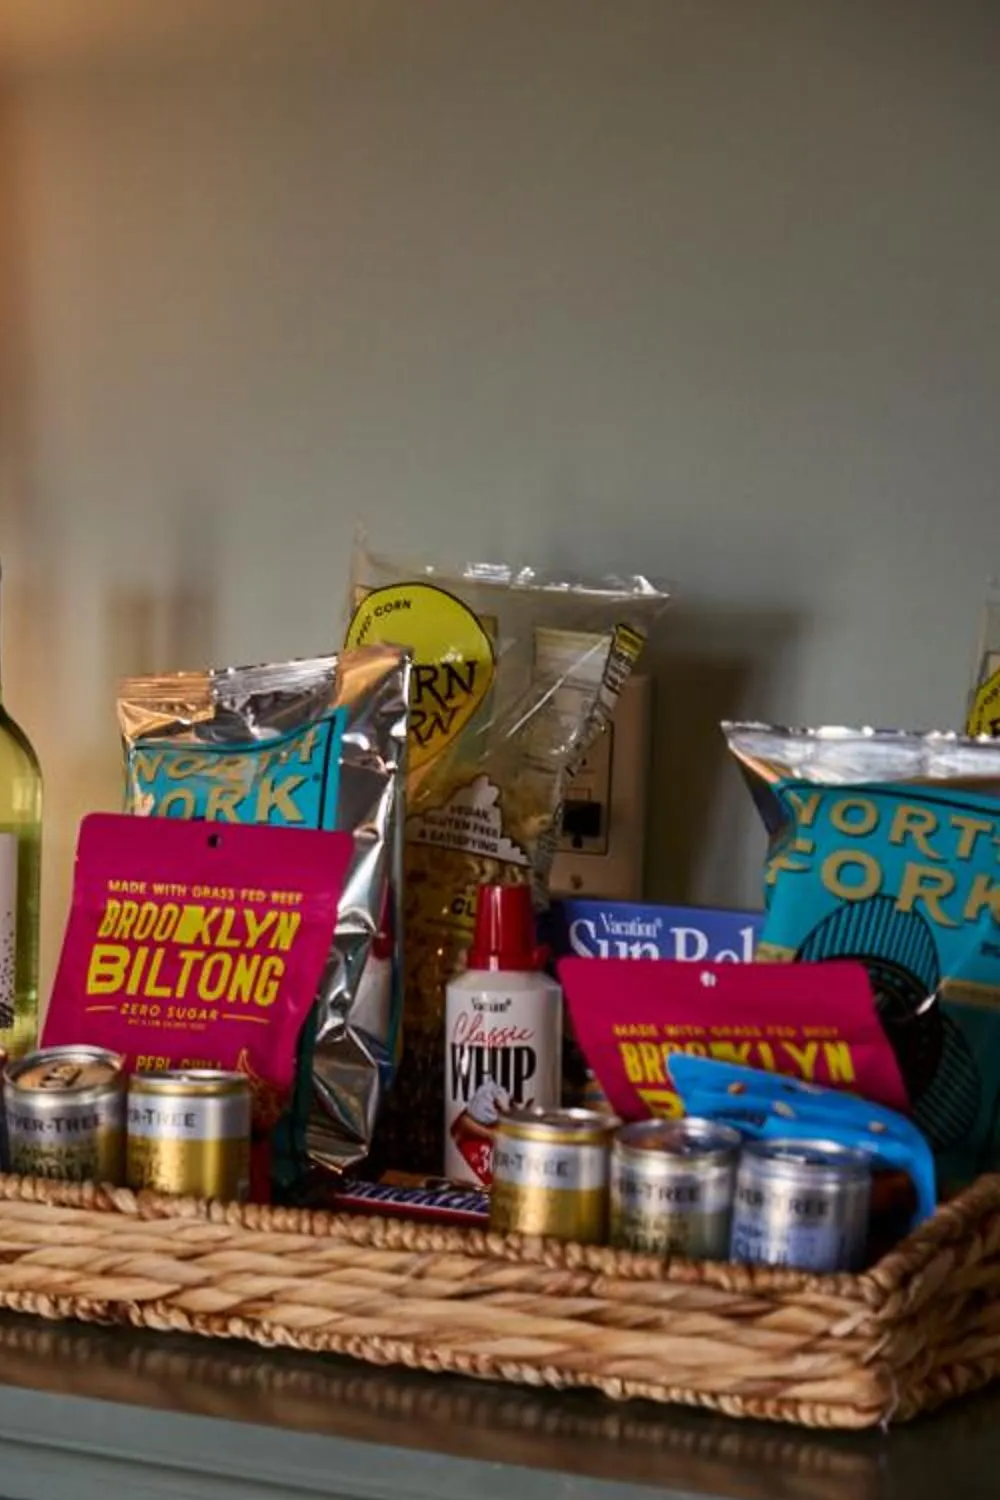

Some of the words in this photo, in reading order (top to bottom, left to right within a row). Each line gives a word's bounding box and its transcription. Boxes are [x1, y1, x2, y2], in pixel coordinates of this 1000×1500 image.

[411, 659, 478, 713] RN
[157, 773, 305, 822] ORK
[790, 792, 1000, 864] NORT
[108, 880, 147, 894] MADE
[152, 883, 187, 897] WITH
[192, 885, 235, 901] GRASS
[241, 889, 266, 902] FED
[271, 891, 303, 905] BEEF
[97, 898, 301, 951] BROOKLYN
[86, 943, 285, 1007] BILTONG
[120, 1003, 161, 1018] ZERO
[167, 1005, 218, 1021] SUGAR
[452, 1011, 535, 1047] Classic
[451, 1043, 536, 1104] WHIP
[618, 1040, 856, 1084] BRKLYN
